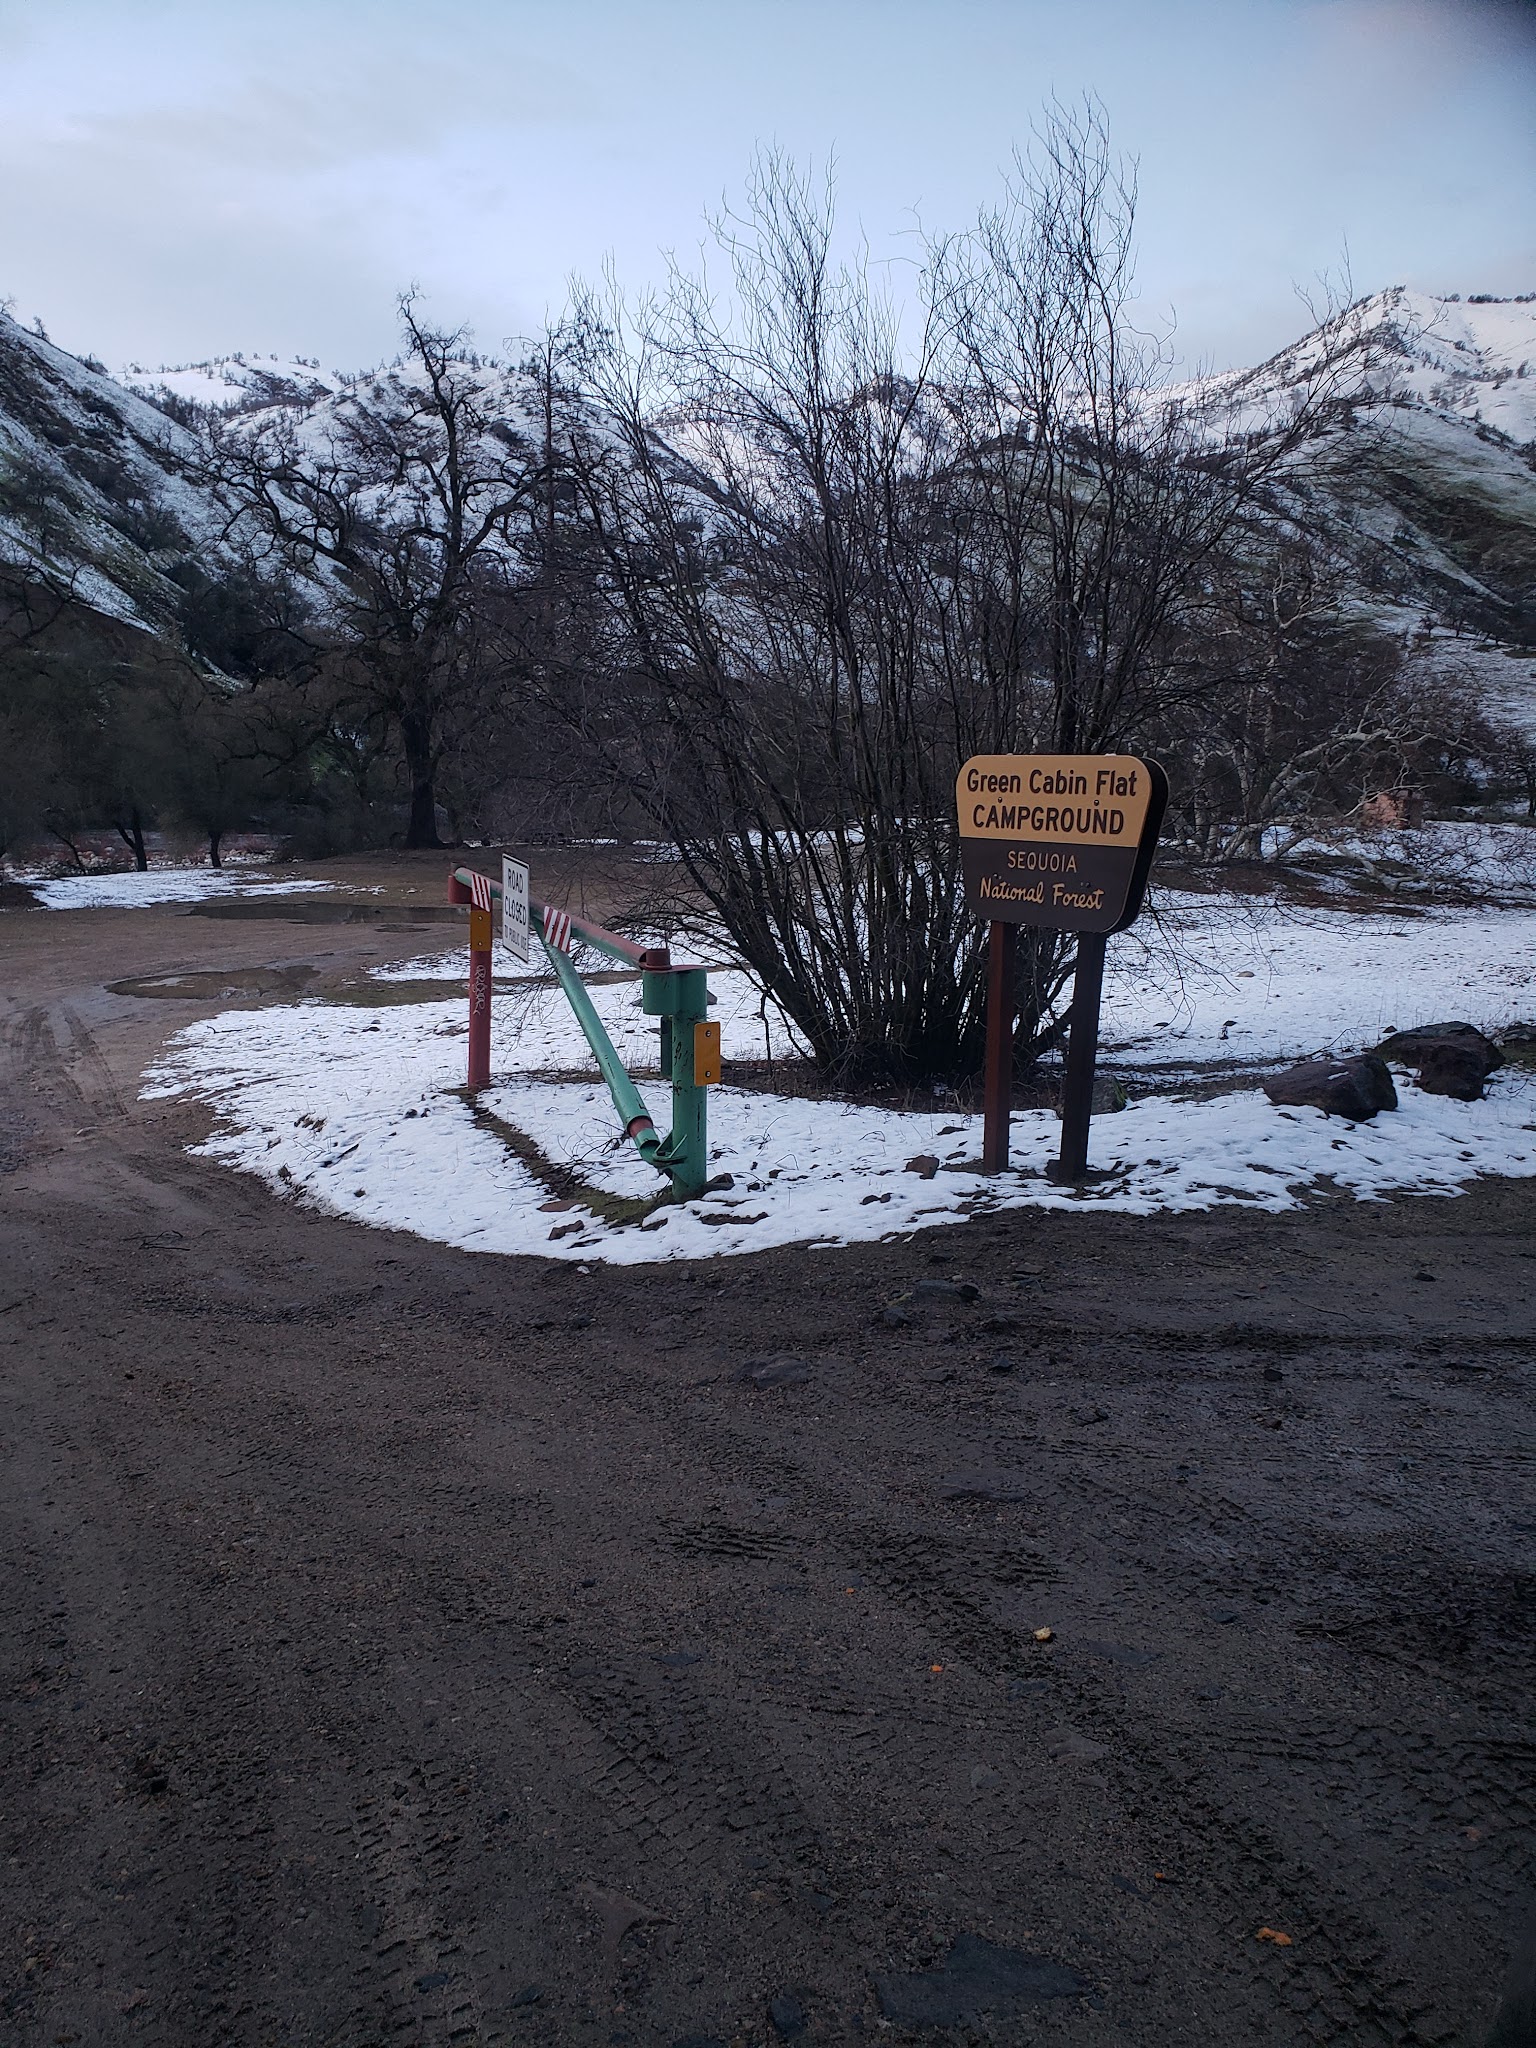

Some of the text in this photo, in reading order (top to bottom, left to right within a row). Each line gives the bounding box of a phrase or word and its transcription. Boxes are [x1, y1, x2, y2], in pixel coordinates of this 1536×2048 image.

[967, 768, 1138, 797] Green Cabin Flat
[972, 804, 1125, 835] CAMPGROUND
[1007, 850, 1077, 873] SEQUOIA
[507, 867, 524, 893] ROAD
[979, 876, 1105, 910] National Forest
[504, 895, 527, 926] CLOSED
